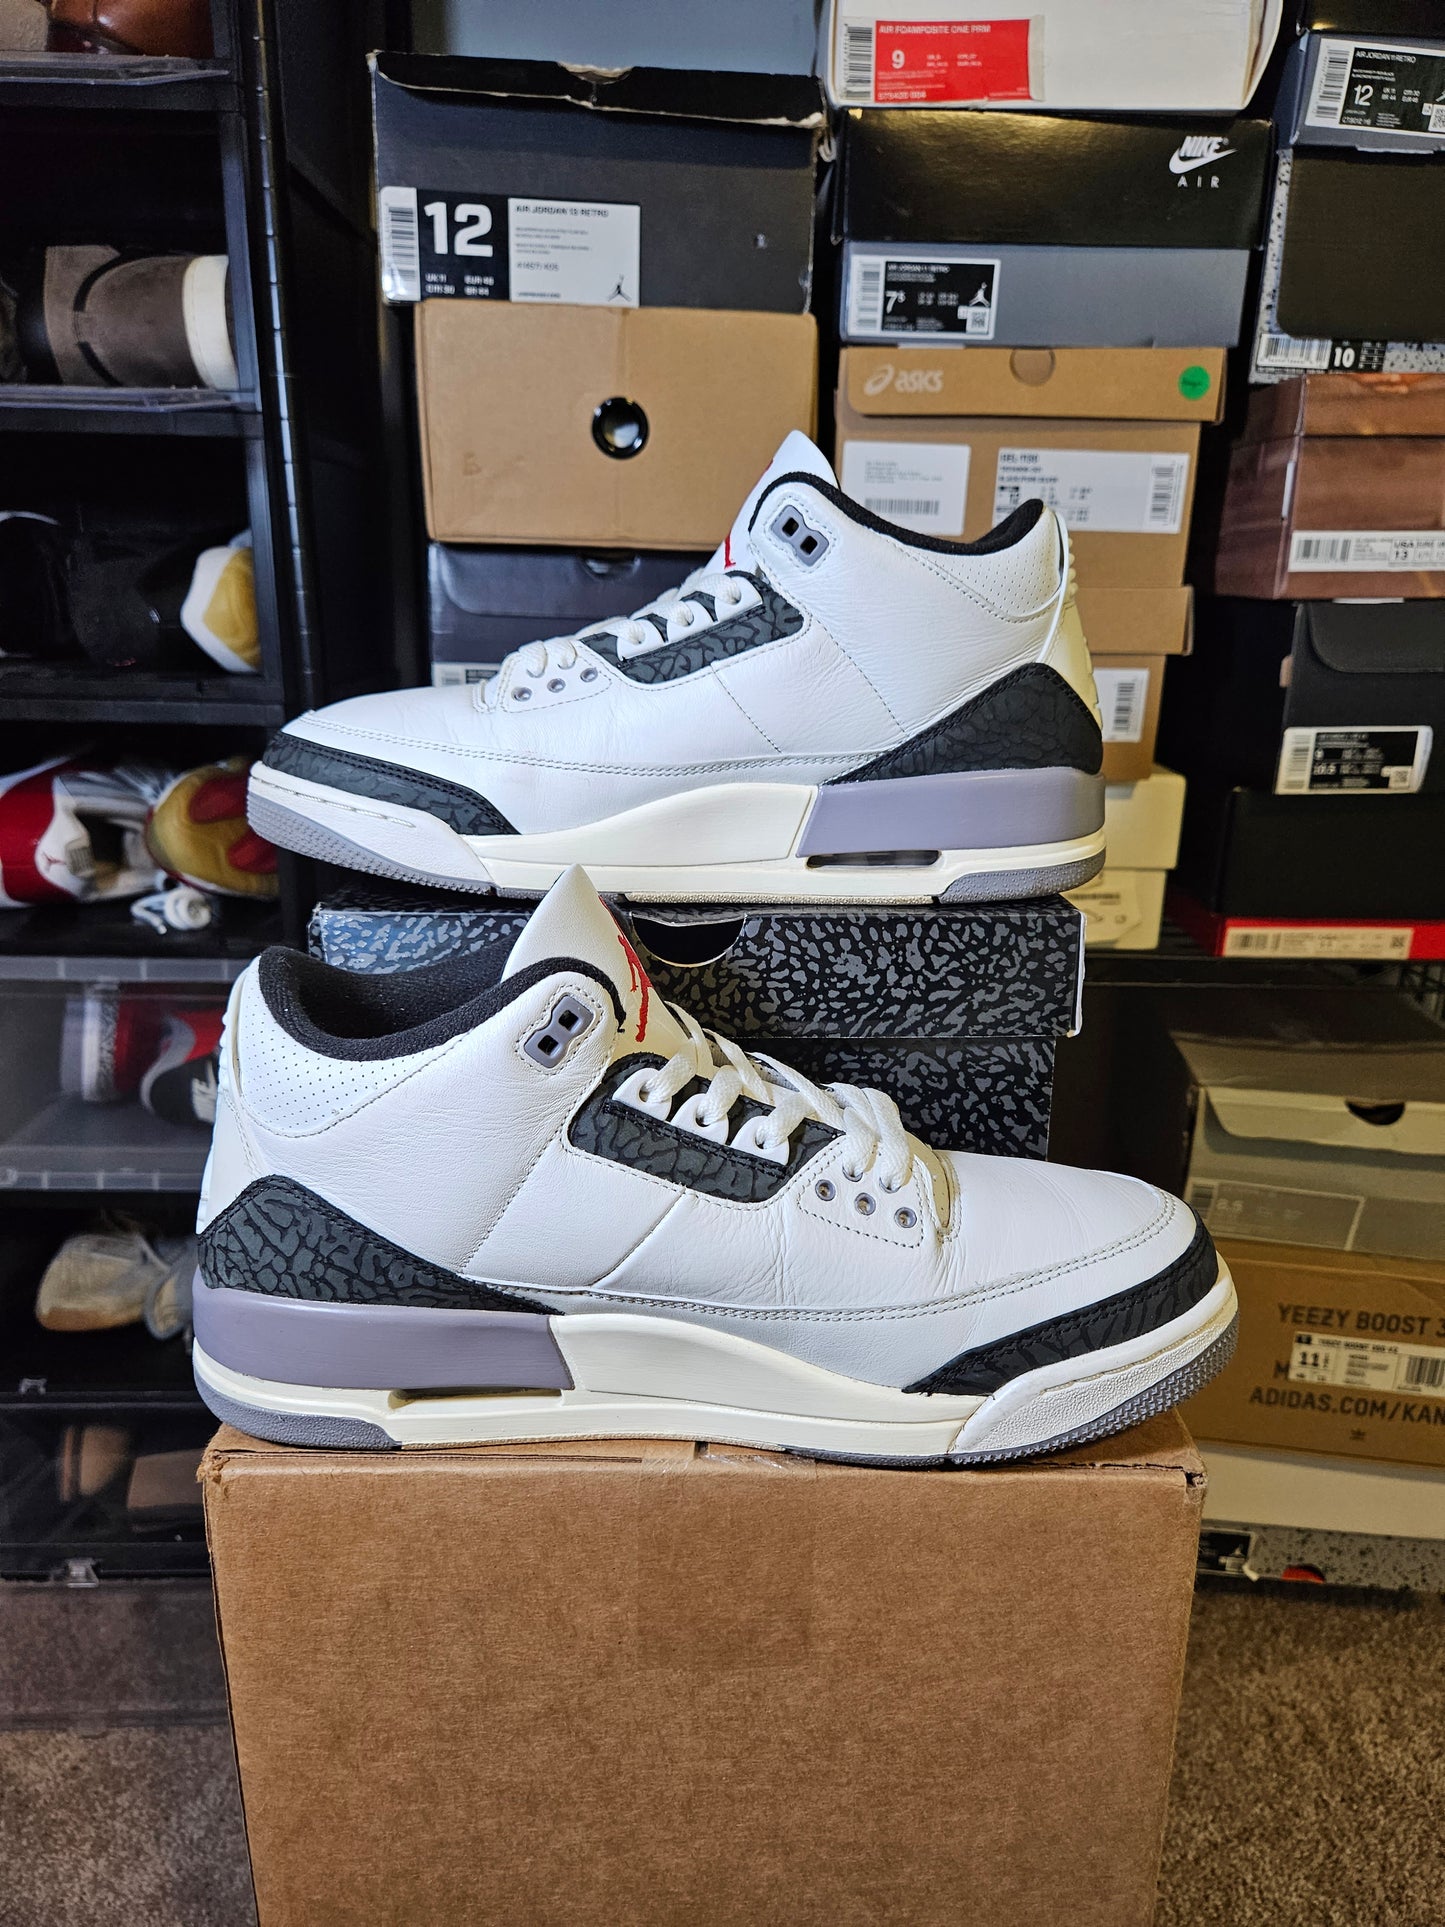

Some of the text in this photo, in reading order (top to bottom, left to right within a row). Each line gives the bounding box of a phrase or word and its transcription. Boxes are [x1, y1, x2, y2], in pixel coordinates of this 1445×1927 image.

[879, 26, 894, 34] AIR
[892, 50, 905, 69] 9
[1354, 84, 1374, 106] 12
[1179, 136, 1223, 158] NIKE
[1177, 175, 1220, 188] AIR
[516, 205, 529, 213] AIR
[532, 206, 567, 215] JORDAN
[424, 202, 493, 257] 12
[1334, 346, 1355, 368] 10
[1278, 1303, 1350, 1328] YEEZY
[1356, 1311, 1430, 1336] BOOST
